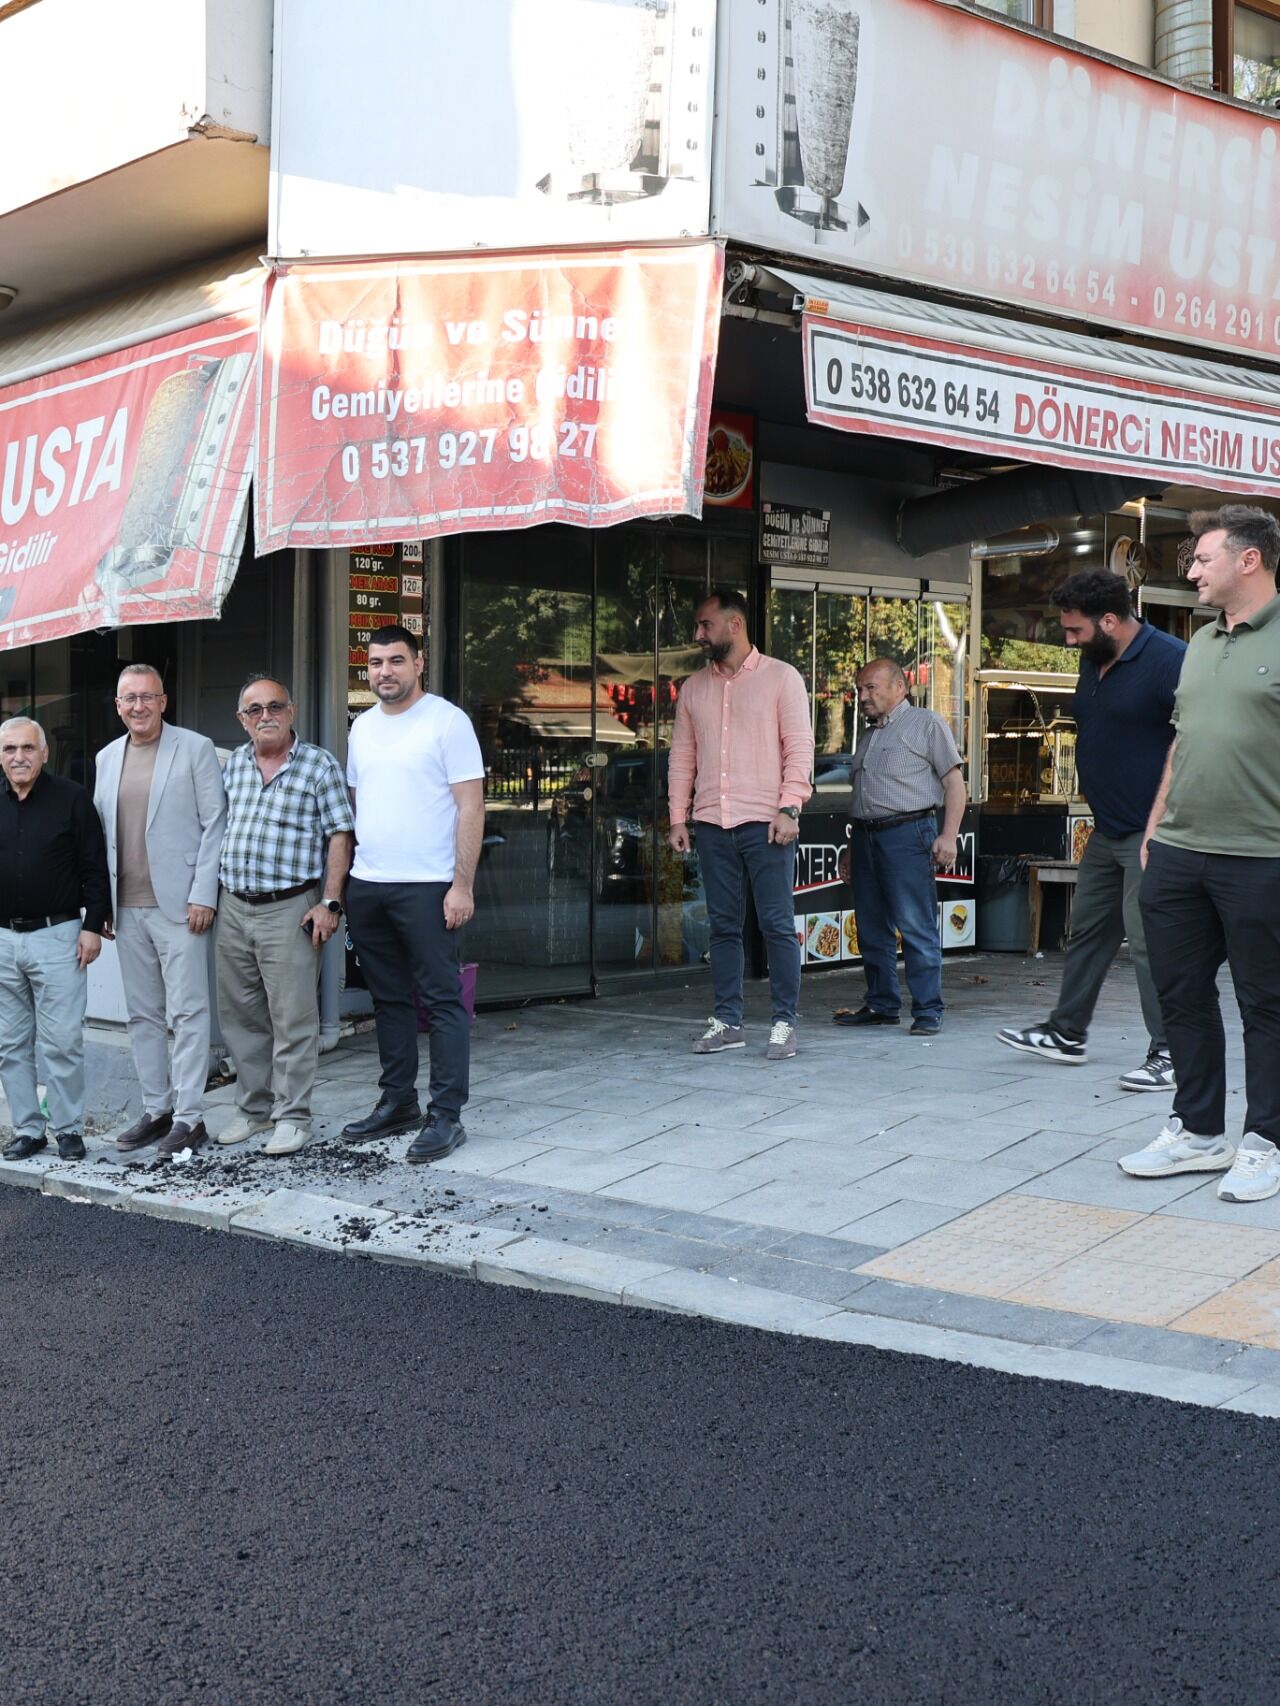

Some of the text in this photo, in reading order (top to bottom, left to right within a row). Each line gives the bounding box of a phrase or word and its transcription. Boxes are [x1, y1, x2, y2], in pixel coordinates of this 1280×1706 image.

[1169, 213, 1280, 300] UST
[924, 229, 976, 275] 538
[986, 245, 1036, 289] 632
[1046, 260, 1078, 297] 64
[1086, 269, 1116, 307] 54
[1153, 285, 1166, 319] 0
[1174, 291, 1218, 330] 264
[1224, 303, 1265, 342] 291
[444, 319, 488, 345] ve
[501, 308, 621, 345] Sünne
[827, 357, 843, 395] 0
[851, 363, 891, 404] 538
[897, 372, 937, 412] 632
[944, 381, 970, 418] 64
[976, 387, 1000, 424] 54
[0, 407, 128, 526] USTA
[341, 421, 598, 483] 0 537 927 98 27
[355, 557, 384, 571] 120 gr.
[356, 594, 381, 608] 80 gr.
[357, 631, 371, 642] 120
[795, 844, 849, 887] NER
